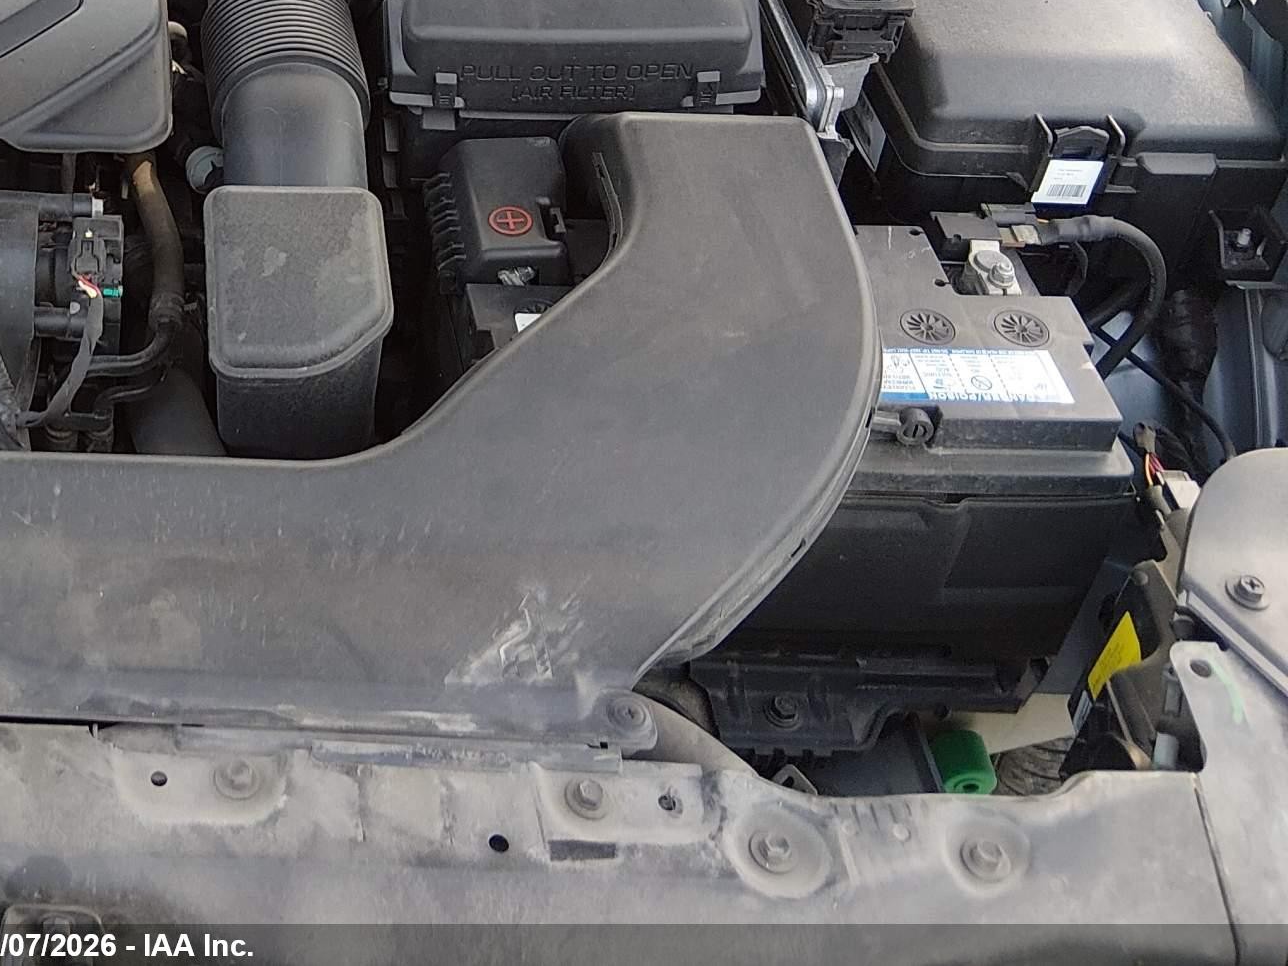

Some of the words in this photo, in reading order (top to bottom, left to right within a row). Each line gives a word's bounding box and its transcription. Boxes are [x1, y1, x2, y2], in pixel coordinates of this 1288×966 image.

[460, 64, 520, 82] PULL
[529, 64, 582, 82] OUT
[586, 64, 617, 81] TO
[625, 62, 694, 81] OPEN
